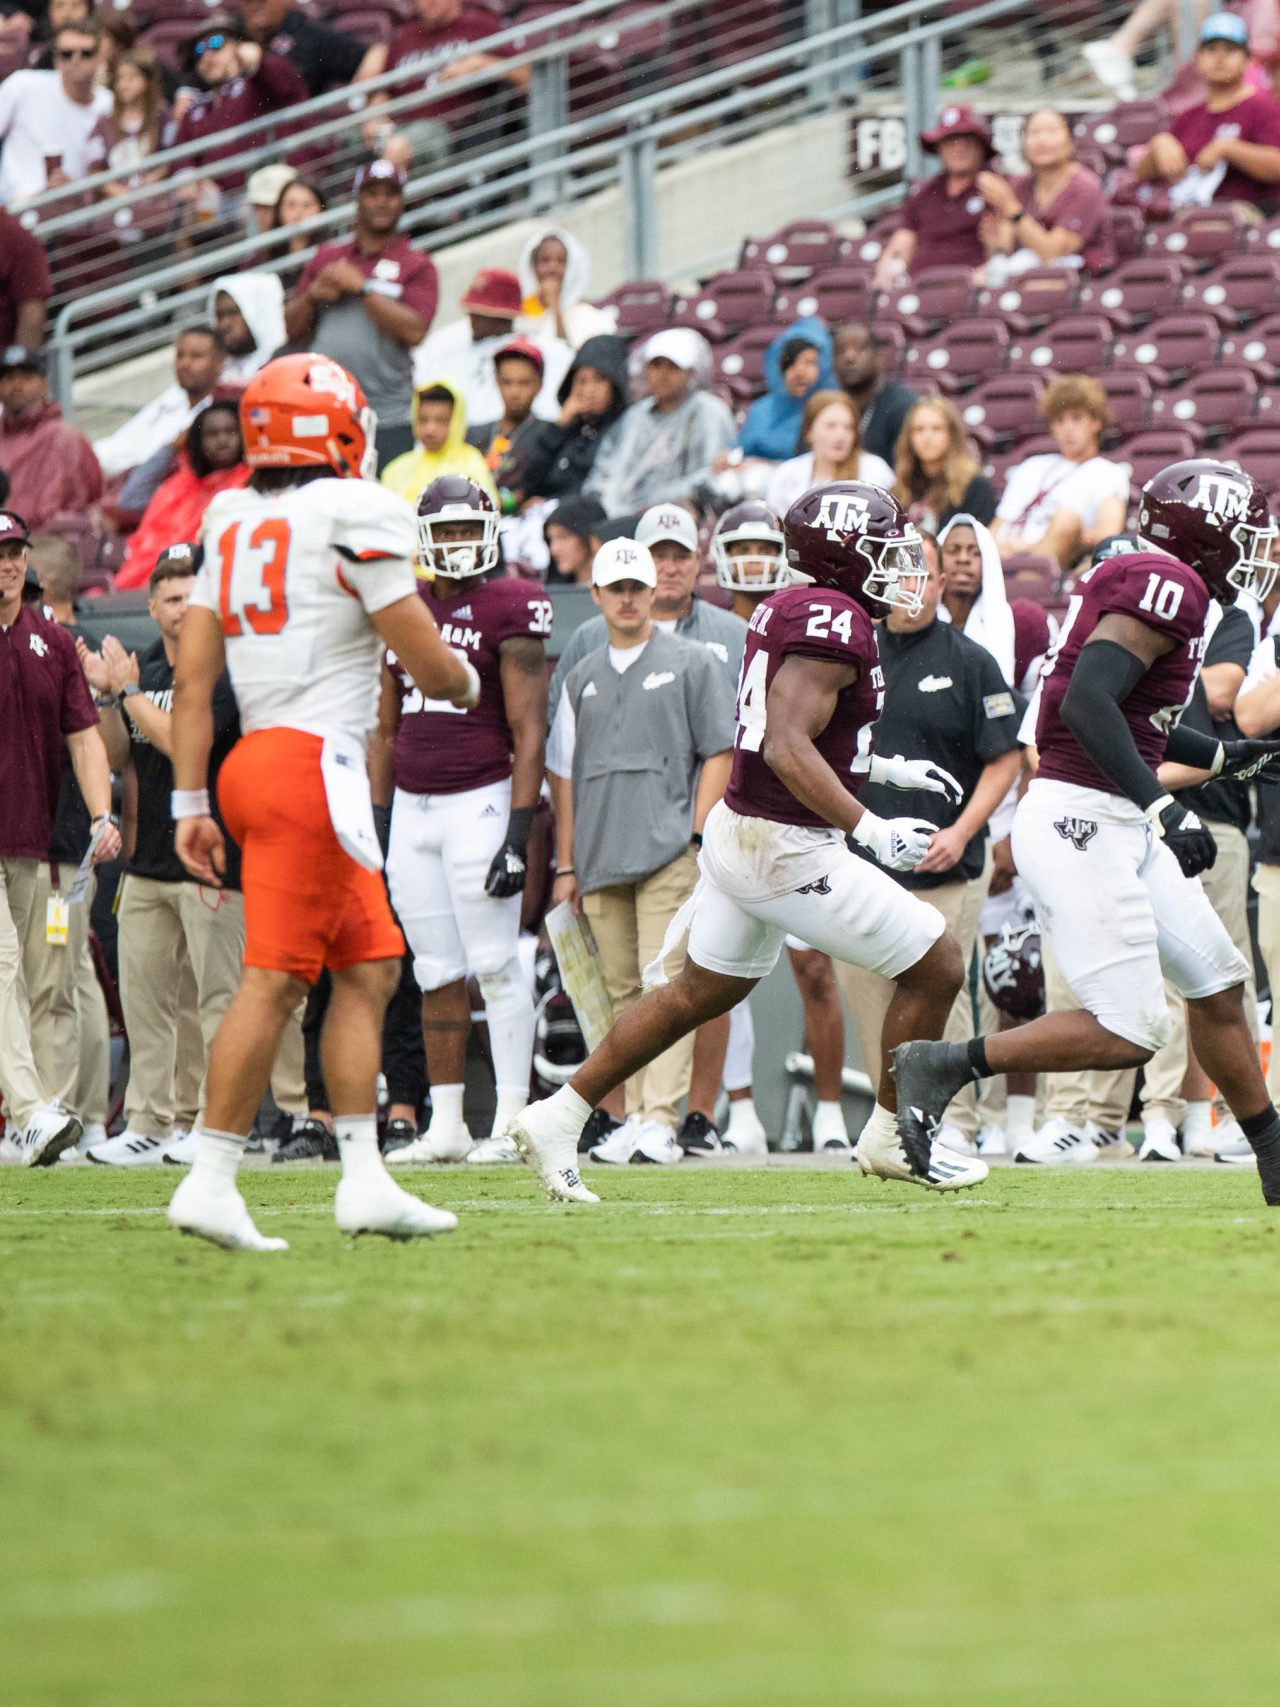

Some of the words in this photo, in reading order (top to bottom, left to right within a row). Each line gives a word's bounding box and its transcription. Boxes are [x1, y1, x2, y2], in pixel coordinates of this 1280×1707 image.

[218, 518, 292, 636] 13
[1138, 572, 1185, 621] 10
[527, 600, 553, 633] 32
[805, 603, 853, 644] 24
